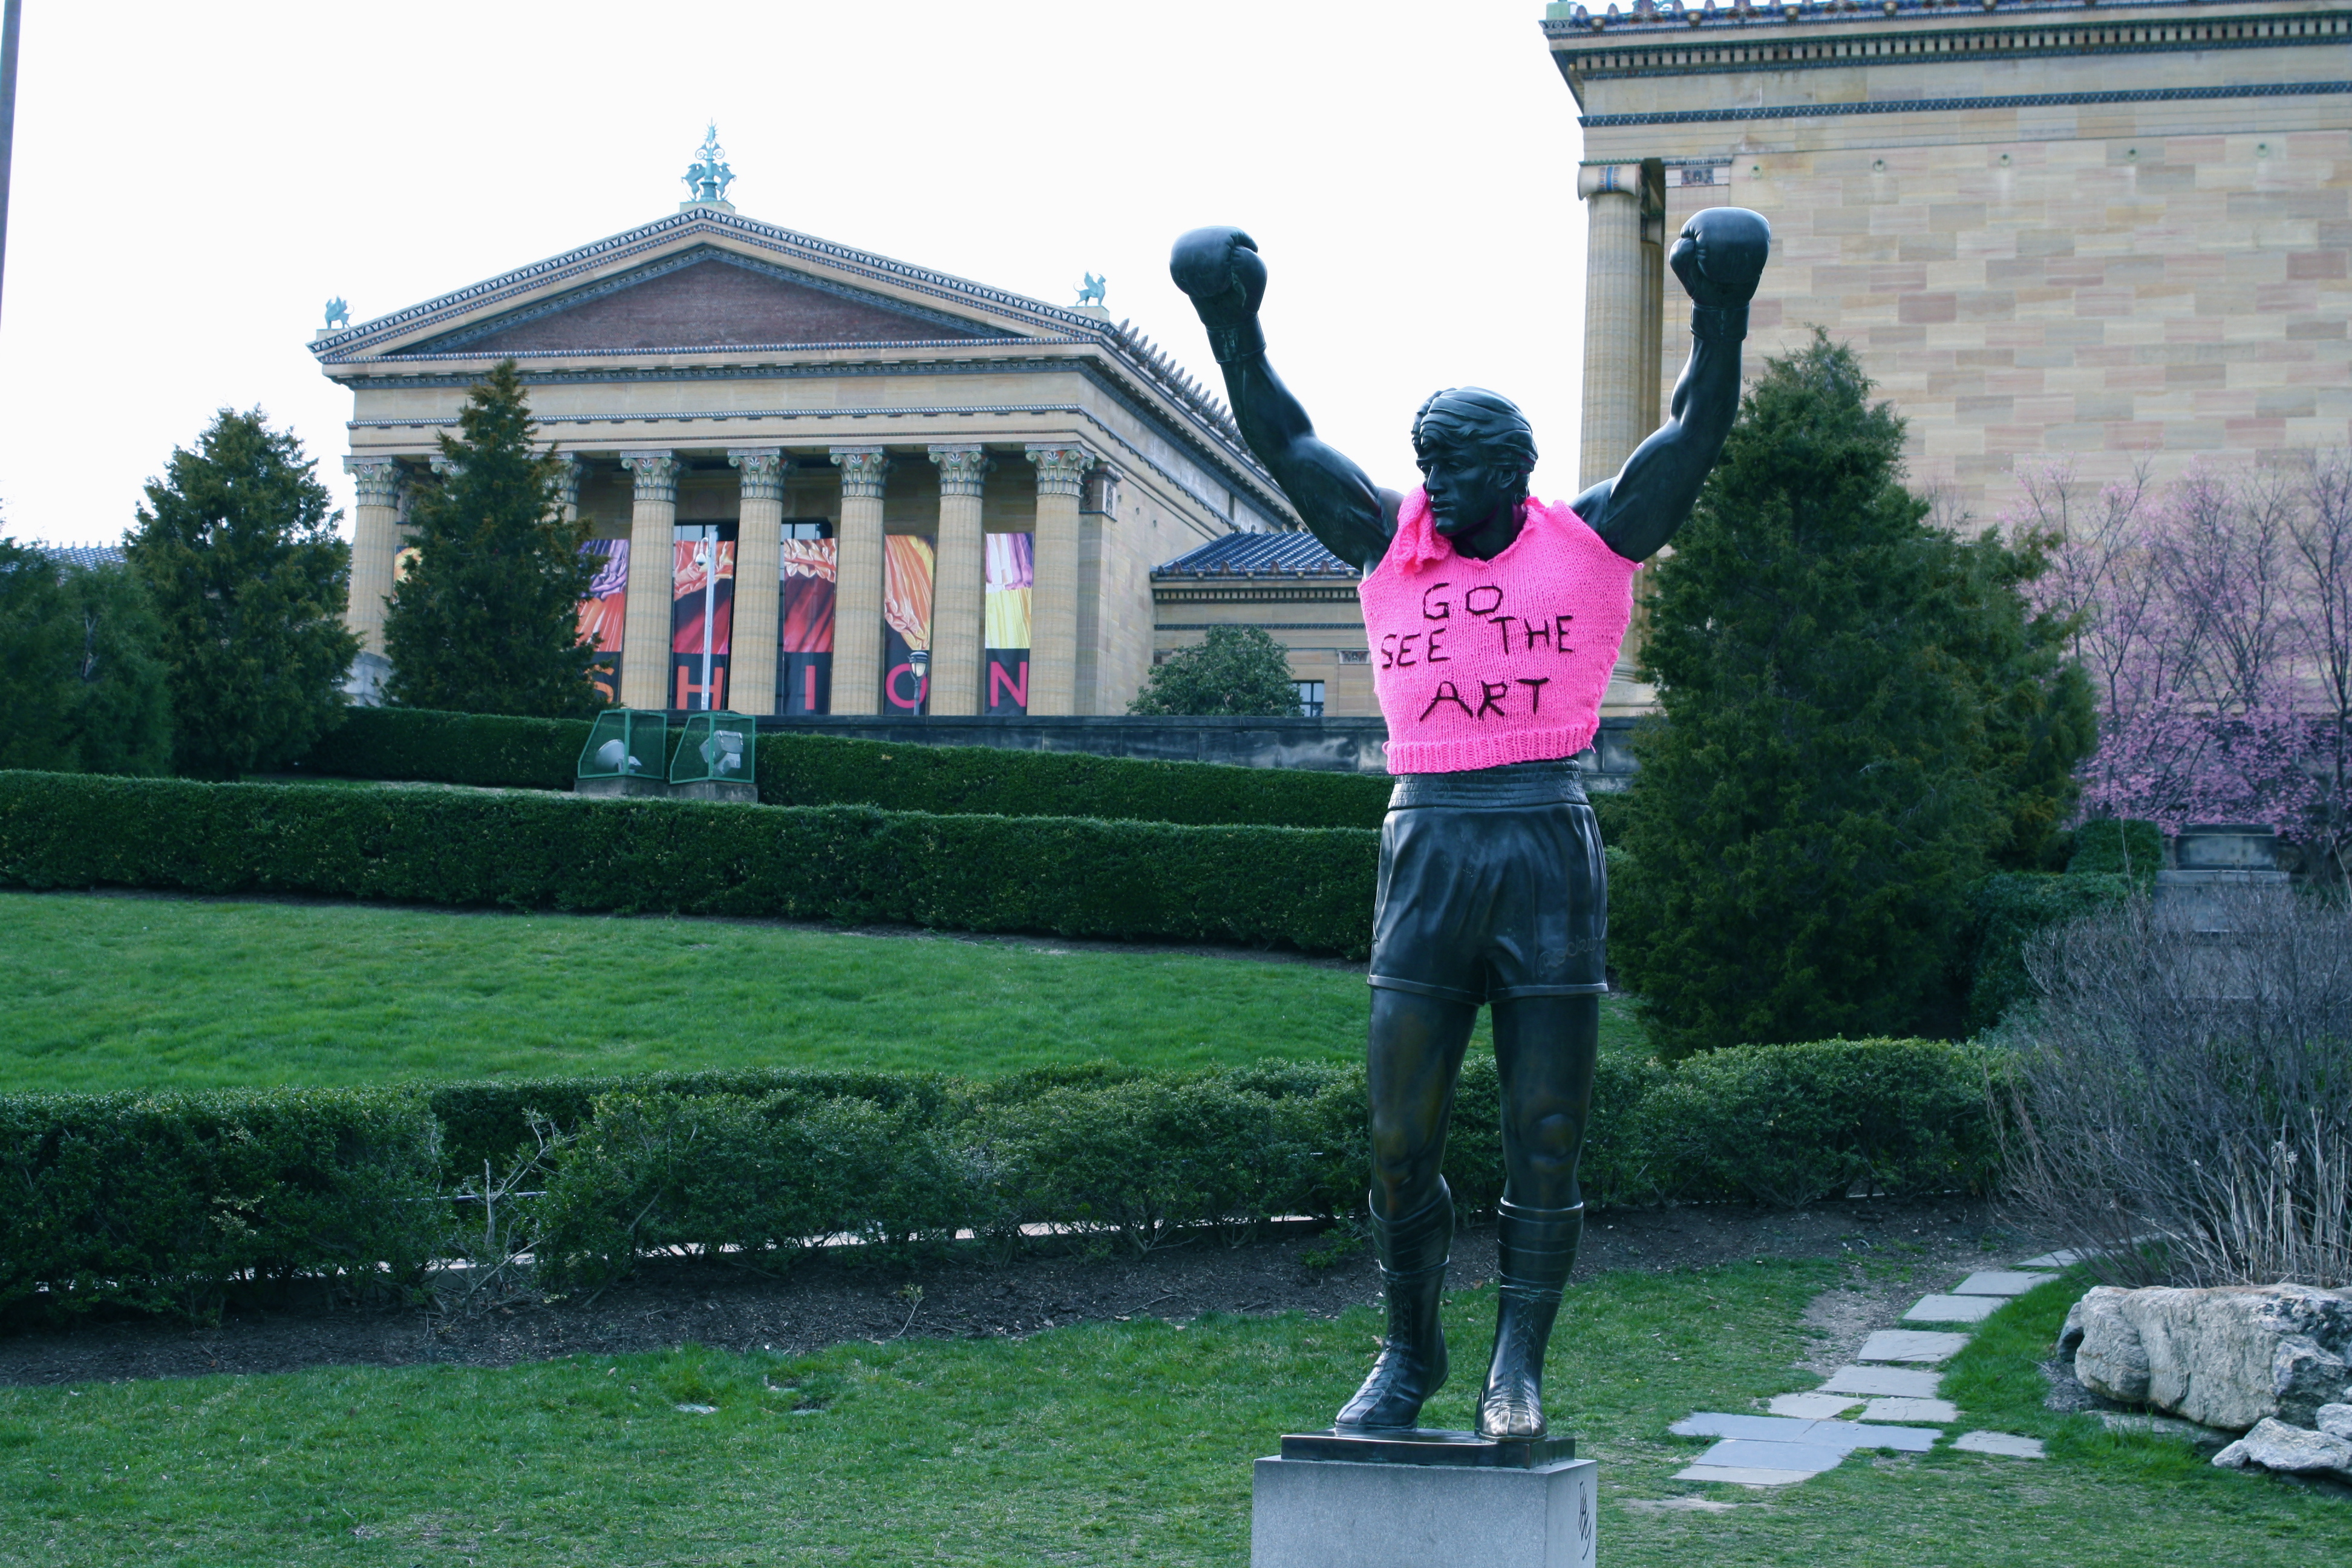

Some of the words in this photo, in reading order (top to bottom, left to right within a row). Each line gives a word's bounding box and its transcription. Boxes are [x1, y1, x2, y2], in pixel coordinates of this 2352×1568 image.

[1423, 582, 1503, 620] GO
[1380, 627, 1451, 669] SEE
[1488, 615, 1573, 655] THE
[1419, 677, 1550, 722] ART
[1537, 935, 1598, 978] Rocky
